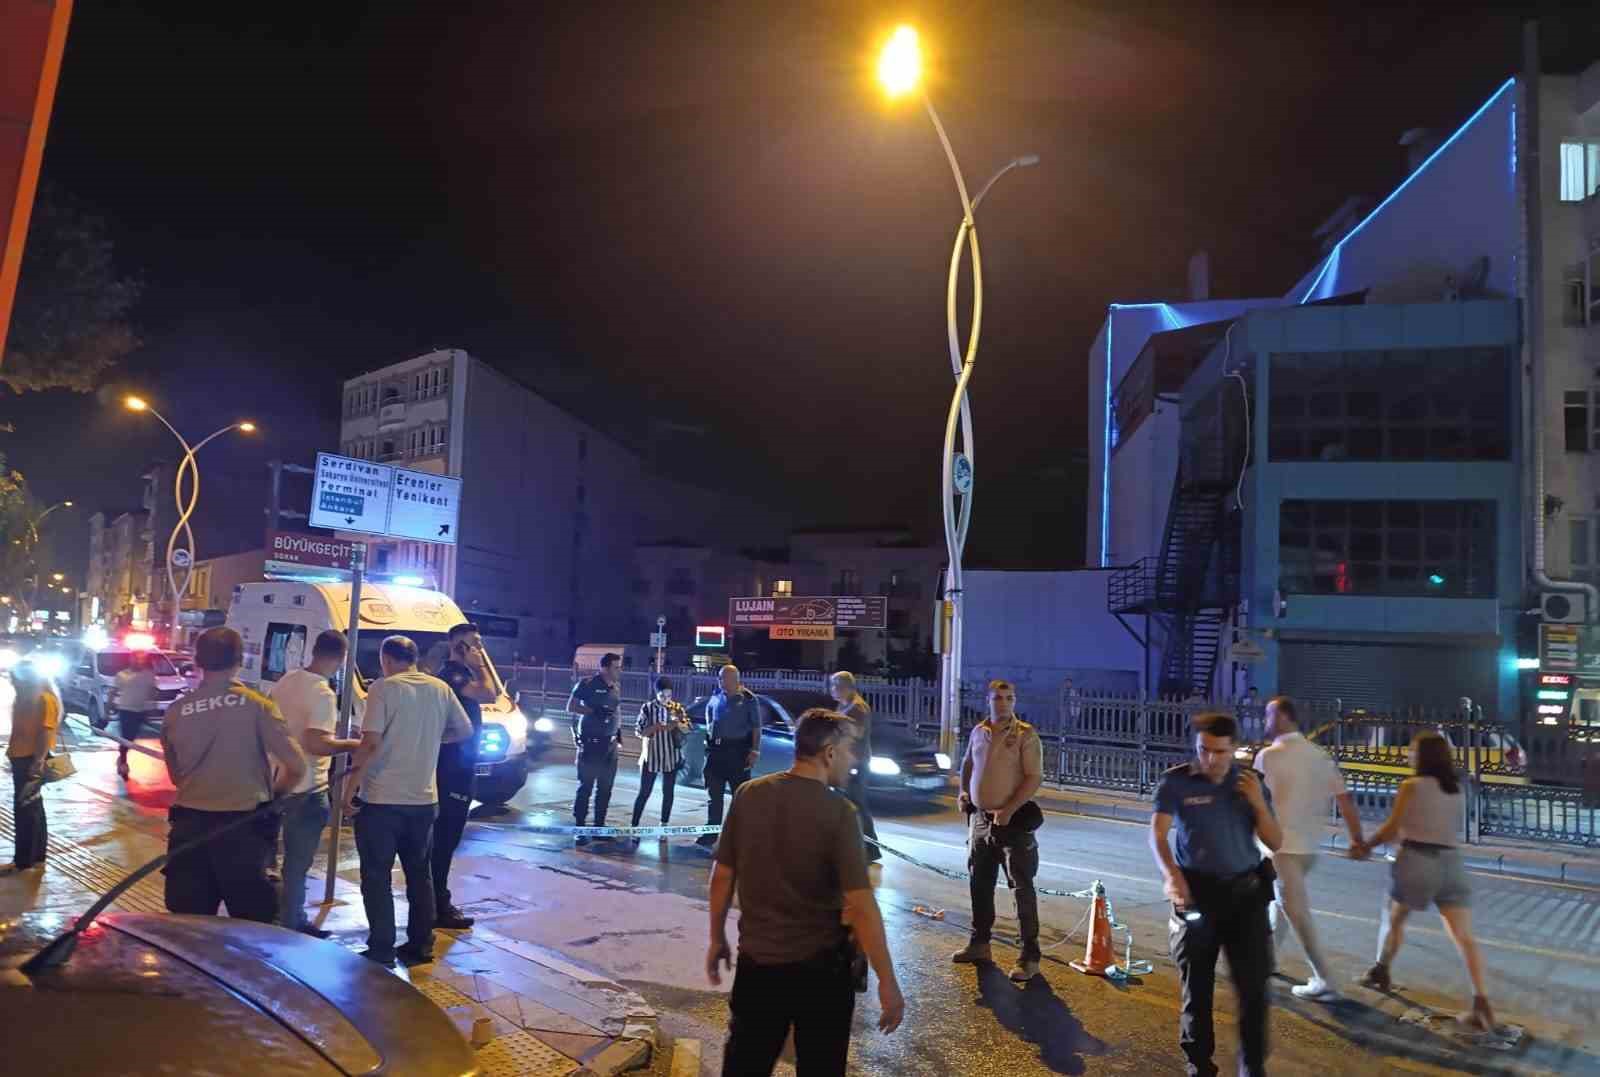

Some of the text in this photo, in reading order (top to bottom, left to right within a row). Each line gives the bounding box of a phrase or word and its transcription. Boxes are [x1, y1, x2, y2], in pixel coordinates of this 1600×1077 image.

[321, 458, 379, 475] Serdivan
[321, 480, 377, 497] Terminal
[397, 474, 442, 491] Erenler
[397, 488, 448, 507] Yenikent
[274, 536, 352, 558] BÜYÜKGEÇİT
[776, 628, 794, 636] OTO
